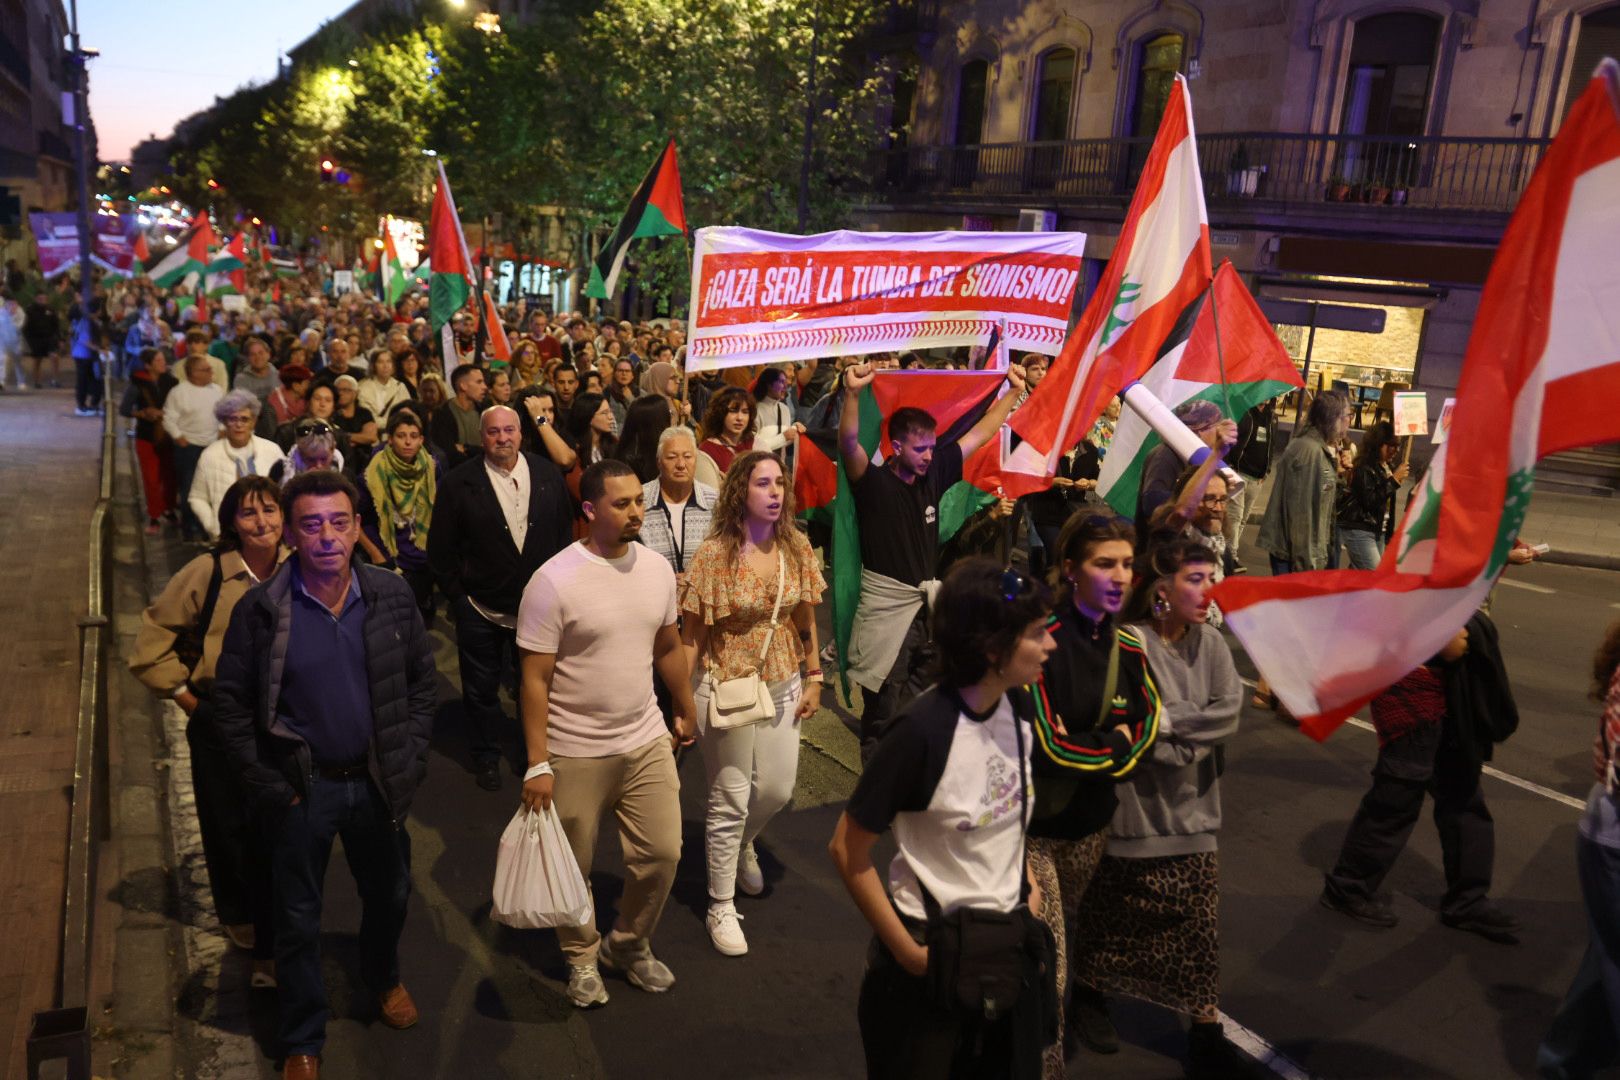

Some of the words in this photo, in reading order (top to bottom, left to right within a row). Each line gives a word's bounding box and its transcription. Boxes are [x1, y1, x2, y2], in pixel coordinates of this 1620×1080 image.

[701, 268, 758, 318] ¡GAZA
[761, 258, 812, 306] SERÁ
[816, 266, 844, 304] LA
[851, 266, 922, 300] TUMBA
[920, 266, 963, 298] DEL
[960, 263, 1079, 305] SIONISMO!
